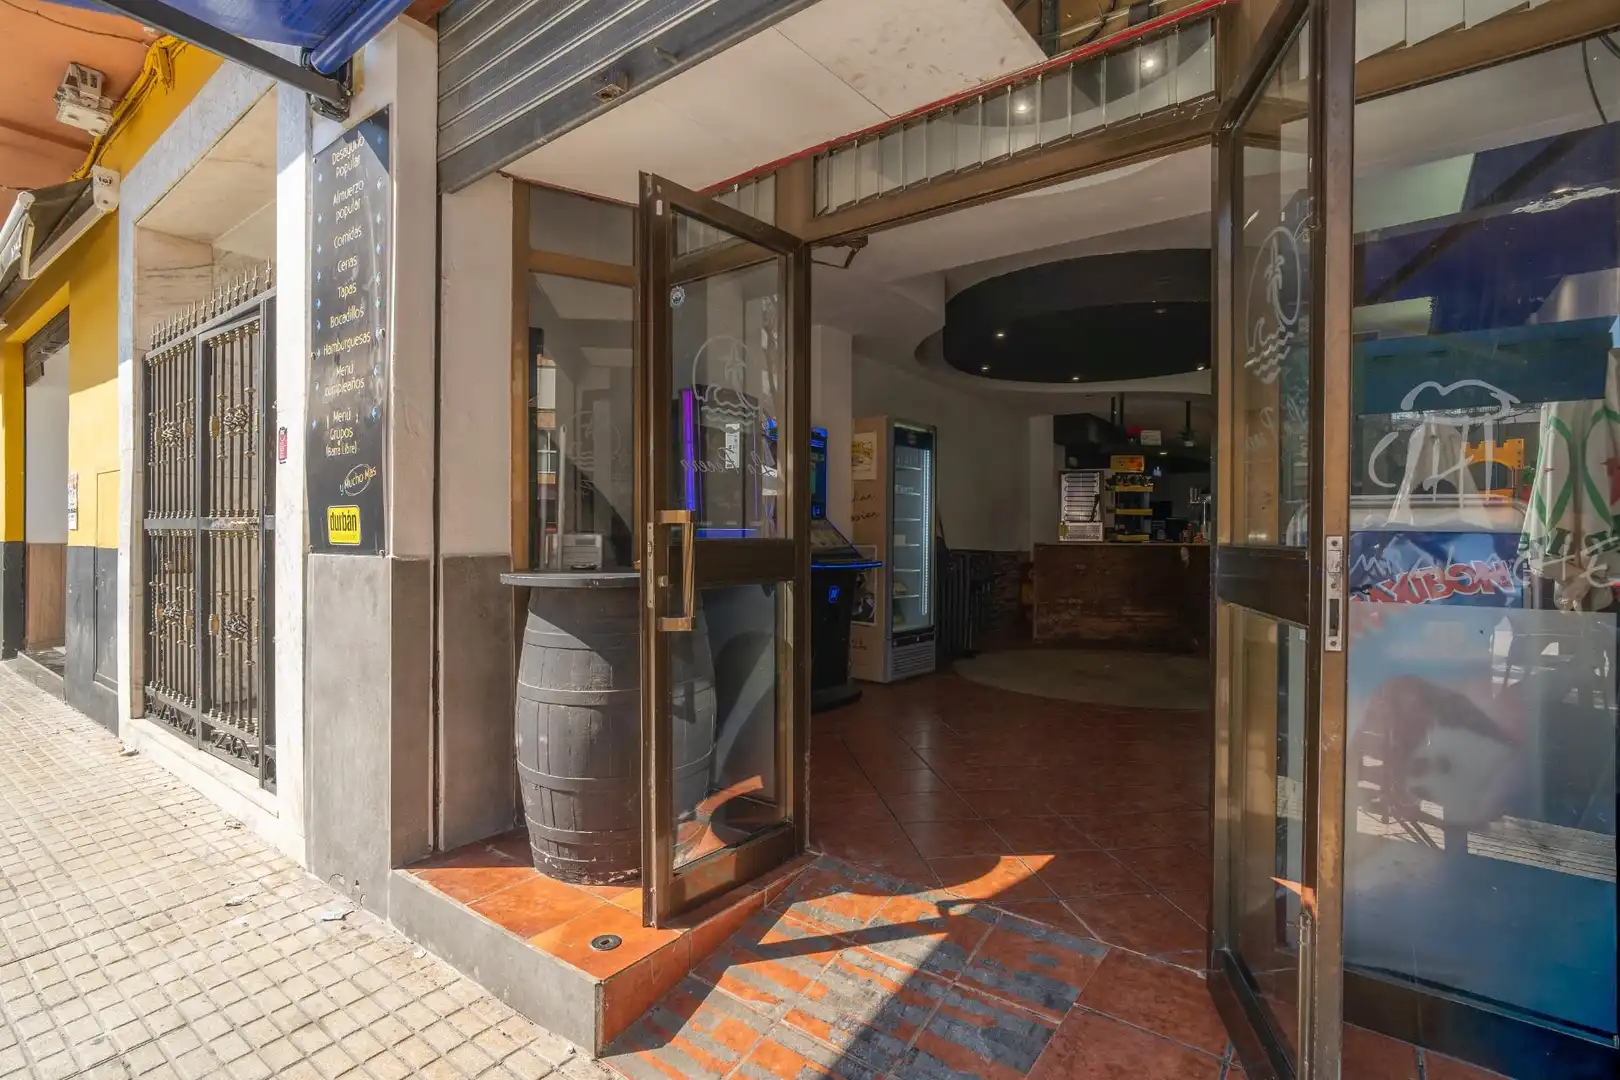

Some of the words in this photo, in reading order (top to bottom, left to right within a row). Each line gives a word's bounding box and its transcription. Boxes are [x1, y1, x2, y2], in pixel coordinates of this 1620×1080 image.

[332, 136, 364, 165] Desayuno
[336, 154, 361, 179] popular
[332, 180, 364, 206] Almuerzo
[335, 198, 361, 224] popular
[333, 225, 362, 249] Comidas
[337, 255, 357, 273] Cenas
[337, 282, 357, 299] Tapas
[330, 305, 364, 328] Bocadillos
[323, 331, 371, 356] Hamburguesas
[336, 361, 354, 377] Menú
[333, 407, 351, 423] Menú
[330, 427, 354, 443] Grupos
[344, 473, 364, 489] Mucho
[330, 510, 357, 531] durbán
